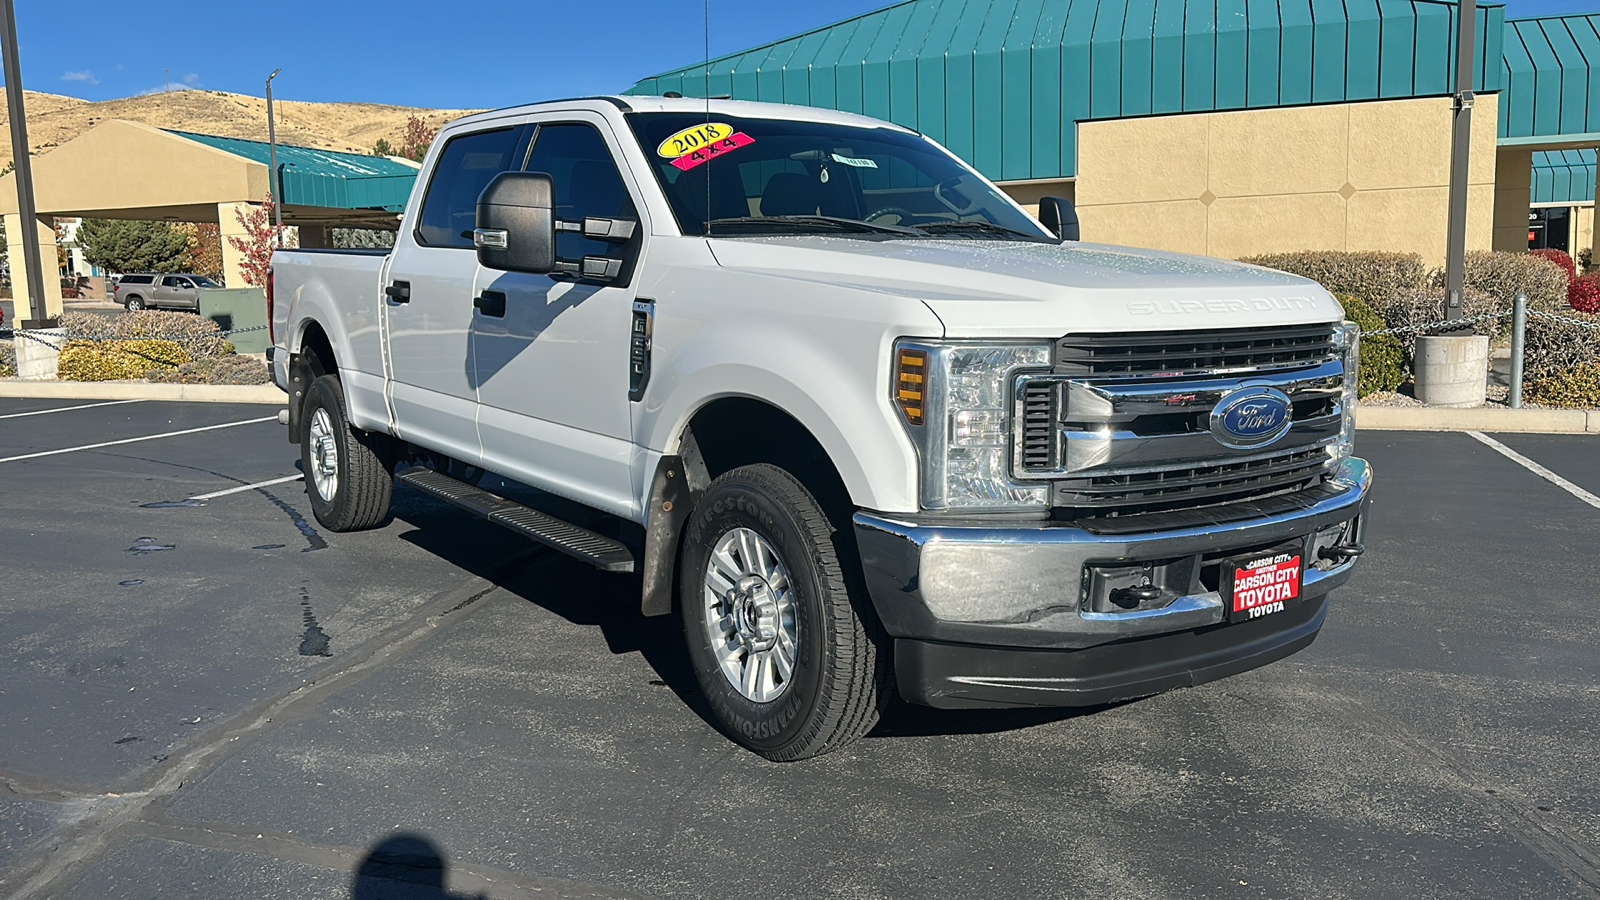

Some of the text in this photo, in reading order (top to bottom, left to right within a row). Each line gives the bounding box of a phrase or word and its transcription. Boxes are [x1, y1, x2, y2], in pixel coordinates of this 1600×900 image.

[673, 125, 720, 153] 2018
[1126, 296, 1317, 315] SUPER DUTY
[1237, 403, 1277, 430] Ford
[1248, 553, 1289, 570] CARSON CITY
[1255, 564, 1277, 575] ANOTHER
[1234, 566, 1299, 593] CARSON CITY
[1238, 581, 1292, 609] TOYOTA
[1248, 600, 1285, 619] TOYOTA
